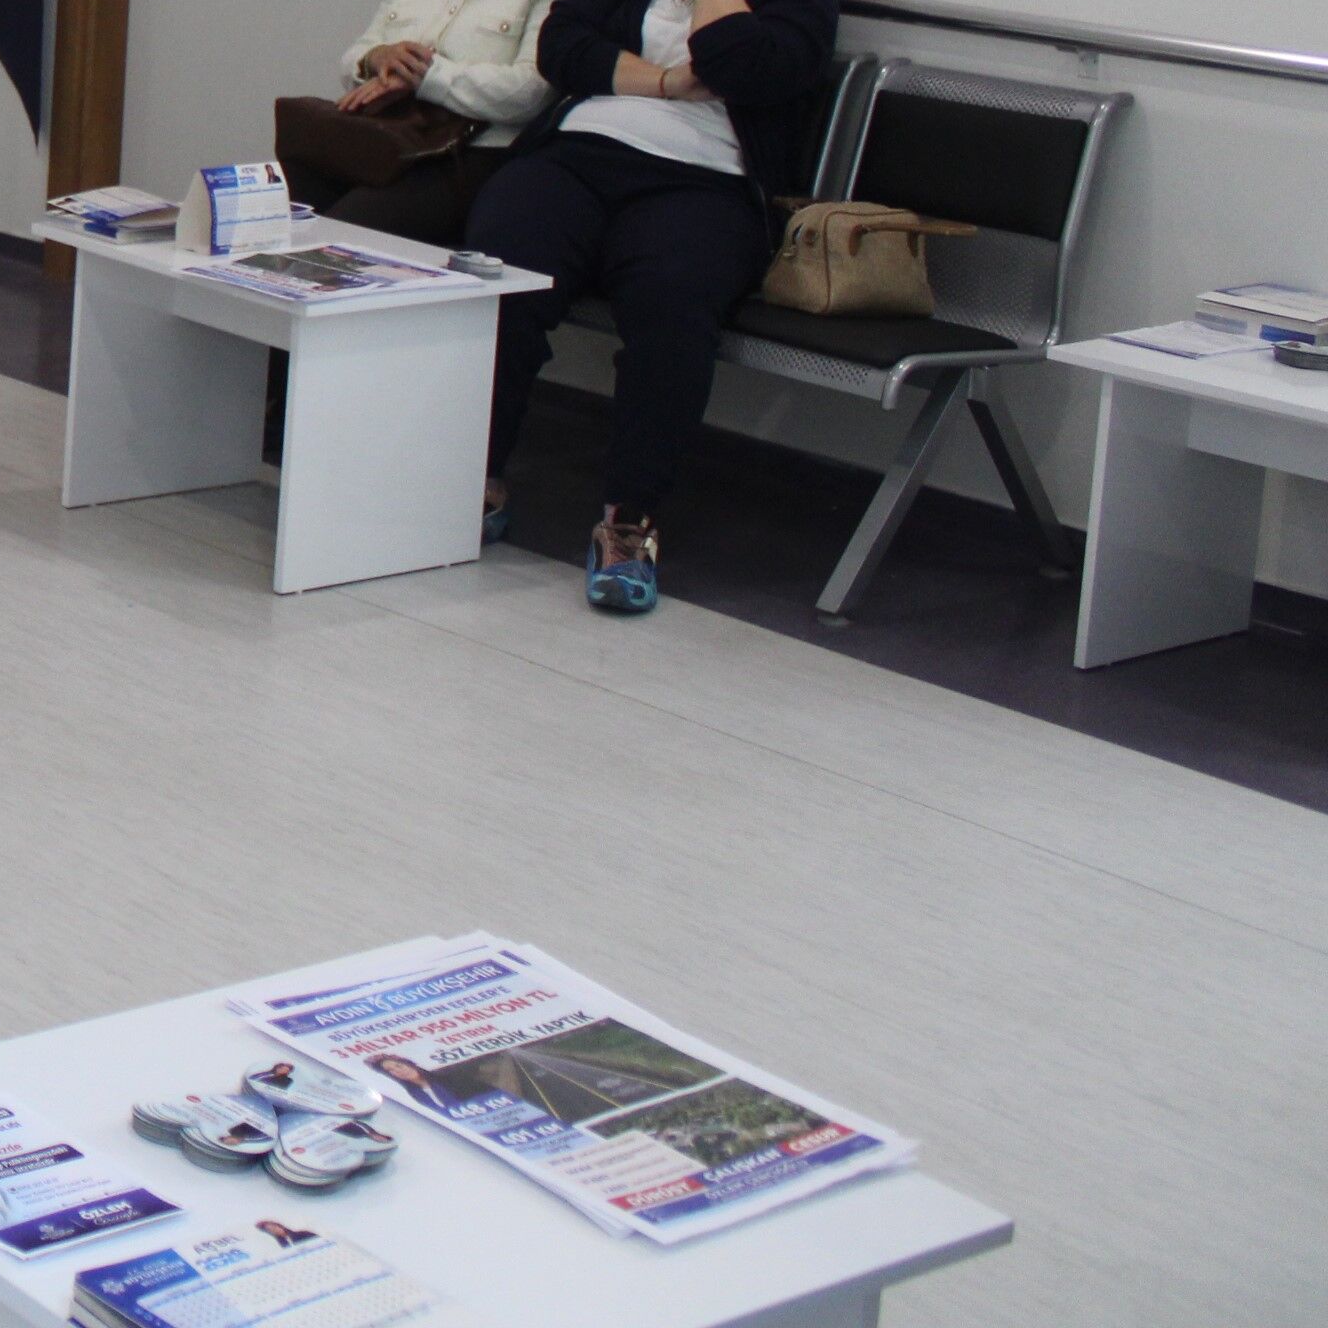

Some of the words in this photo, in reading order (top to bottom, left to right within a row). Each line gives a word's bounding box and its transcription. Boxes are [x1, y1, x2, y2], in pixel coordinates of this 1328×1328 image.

[313, 1002, 375, 1025] AYDIN
[384, 962, 502, 1005] BÜYÜKŞEHİR
[342, 1027, 421, 1056] MİLYAR
[417, 1018, 458, 1035] 950
[453, 995, 532, 1024] MİLYON
[524, 987, 559, 1003] TL
[425, 1044, 471, 1064] SÖZ
[462, 1026, 529, 1052] VERDİK
[528, 1010, 591, 1033] YAPTIK
